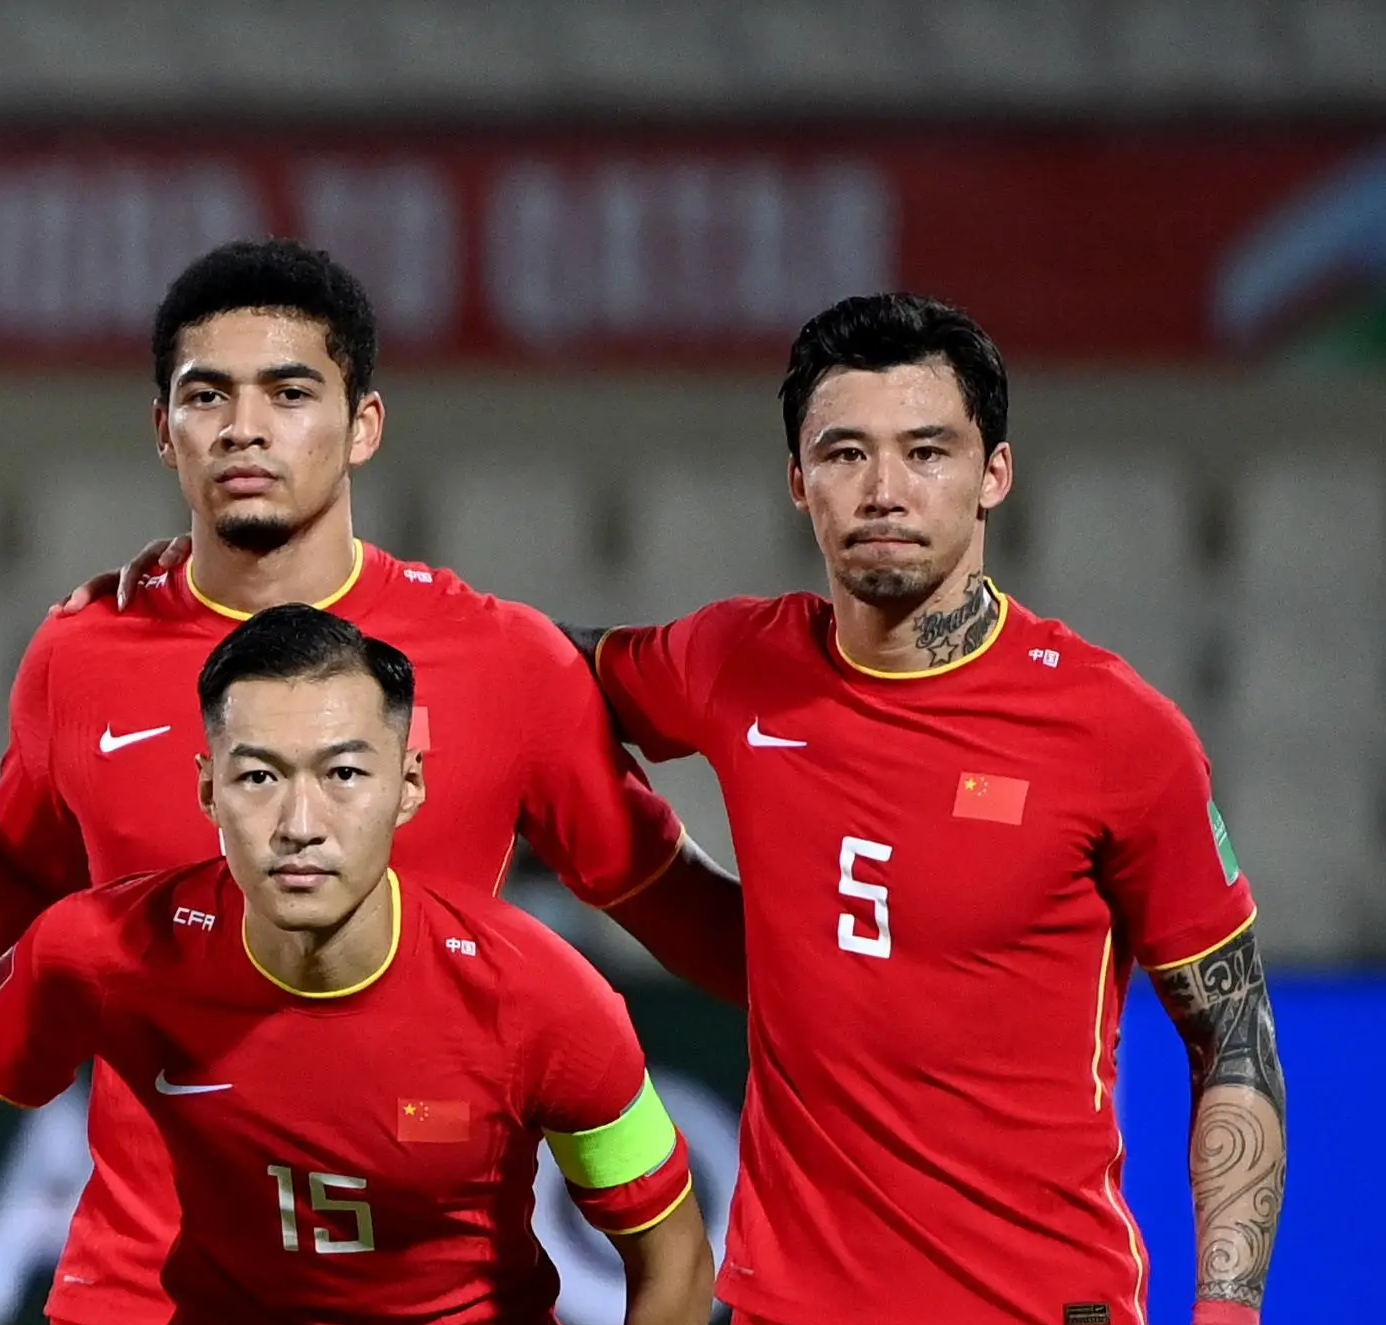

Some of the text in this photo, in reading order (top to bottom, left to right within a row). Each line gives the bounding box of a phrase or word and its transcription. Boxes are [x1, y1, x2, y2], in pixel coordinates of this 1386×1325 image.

[173, 906, 217, 931] CFA
[837, 836, 893, 959] 5
[445, 937, 476, 957] 中国
[266, 1164, 376, 1254] 15
